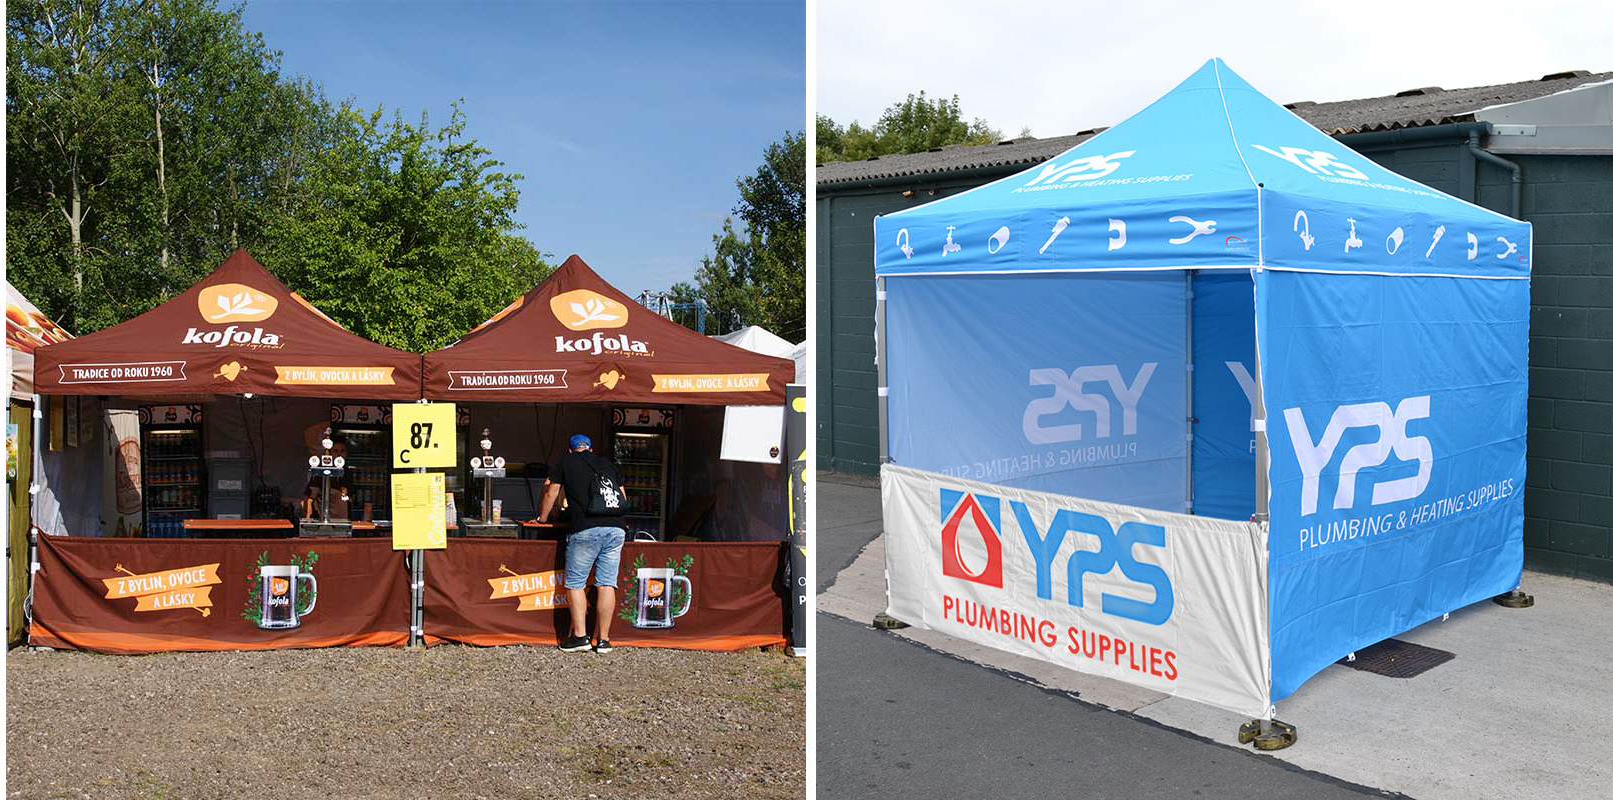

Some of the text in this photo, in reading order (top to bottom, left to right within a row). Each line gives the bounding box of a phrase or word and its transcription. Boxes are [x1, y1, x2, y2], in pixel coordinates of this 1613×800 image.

[1024, 150, 1136, 187] YPS
[1251, 144, 1370, 180] YPS
[1011, 182, 1070, 194] PLUMBING
[1080, 177, 1134, 188] HEATING
[1133, 173, 1194, 184] SUPPLIES
[182, 325, 279, 348] kofola
[554, 332, 648, 356] kofola
[230, 342, 285, 351] original
[604, 350, 655, 358] original
[72, 366, 173, 379] TRADICE OD ROKU 1960
[352, 370, 357, 380] A
[358, 368, 385, 381] LÁSKY
[460, 372, 555, 386] TRADÍCIA OD ROKU 1960
[400, 449, 410, 464] C
[1283, 395, 1434, 517] YPS
[1300, 477, 1514, 552] PLUMBING & HEATING SUPPLIES
[1008, 499, 1175, 626] YPS
[118, 568, 206, 595] Z BYLIN, OVOCE
[502, 581, 510, 594] Z
[511, 575, 547, 593] BYLIN,
[153, 590, 195, 609] A LÁSKY
[268, 596, 289, 608] kofola
[535, 595, 541, 608] A
[643, 597, 664, 608] kofola
[943, 594, 1178, 681] PLUMBING SUPPLIES
